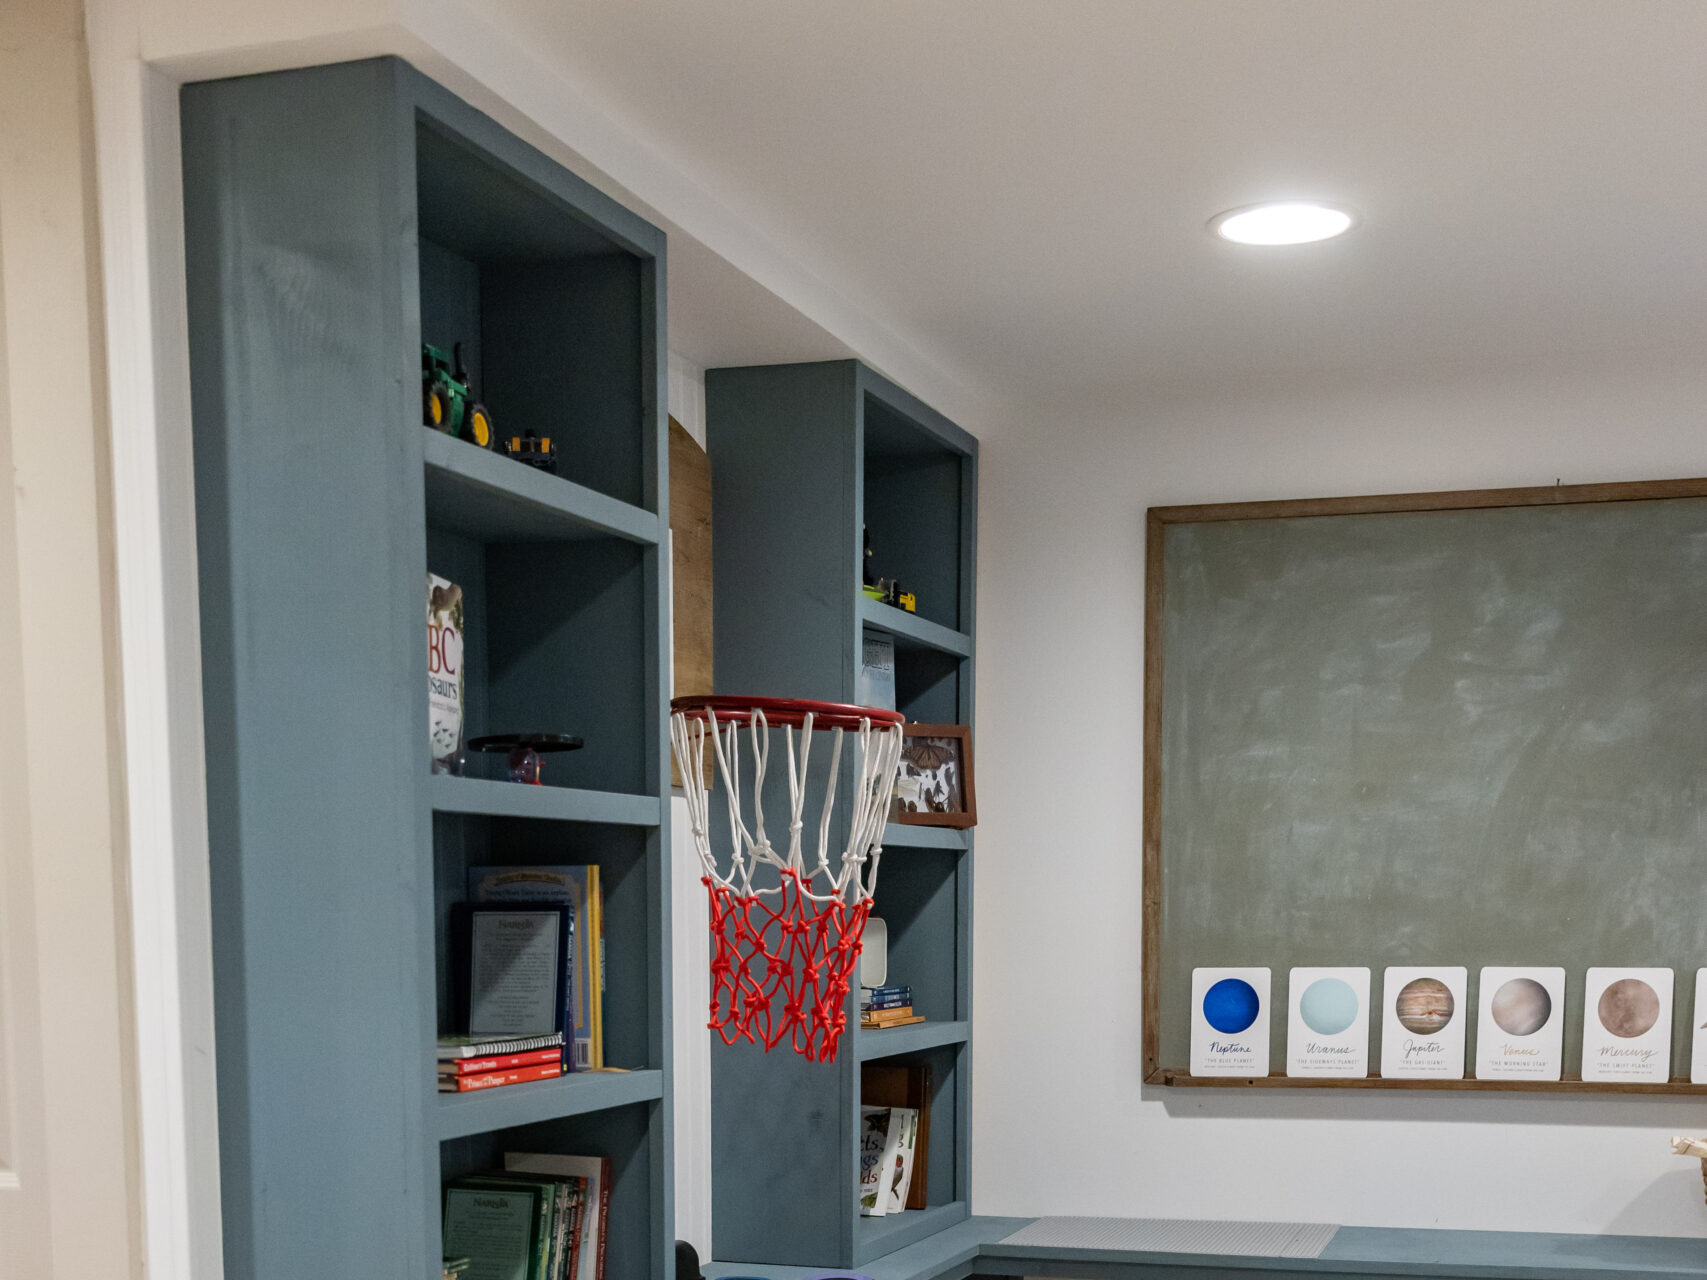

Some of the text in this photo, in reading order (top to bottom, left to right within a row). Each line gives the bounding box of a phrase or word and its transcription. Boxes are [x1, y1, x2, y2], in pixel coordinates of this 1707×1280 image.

[1209, 1041, 1252, 1055] Neptune
[1305, 1042, 1356, 1054] Uranus
[1402, 1039, 1446, 1059] Jupiter
[1498, 1043, 1541, 1056] Venus
[1596, 1046, 1659, 1063] Mercury
